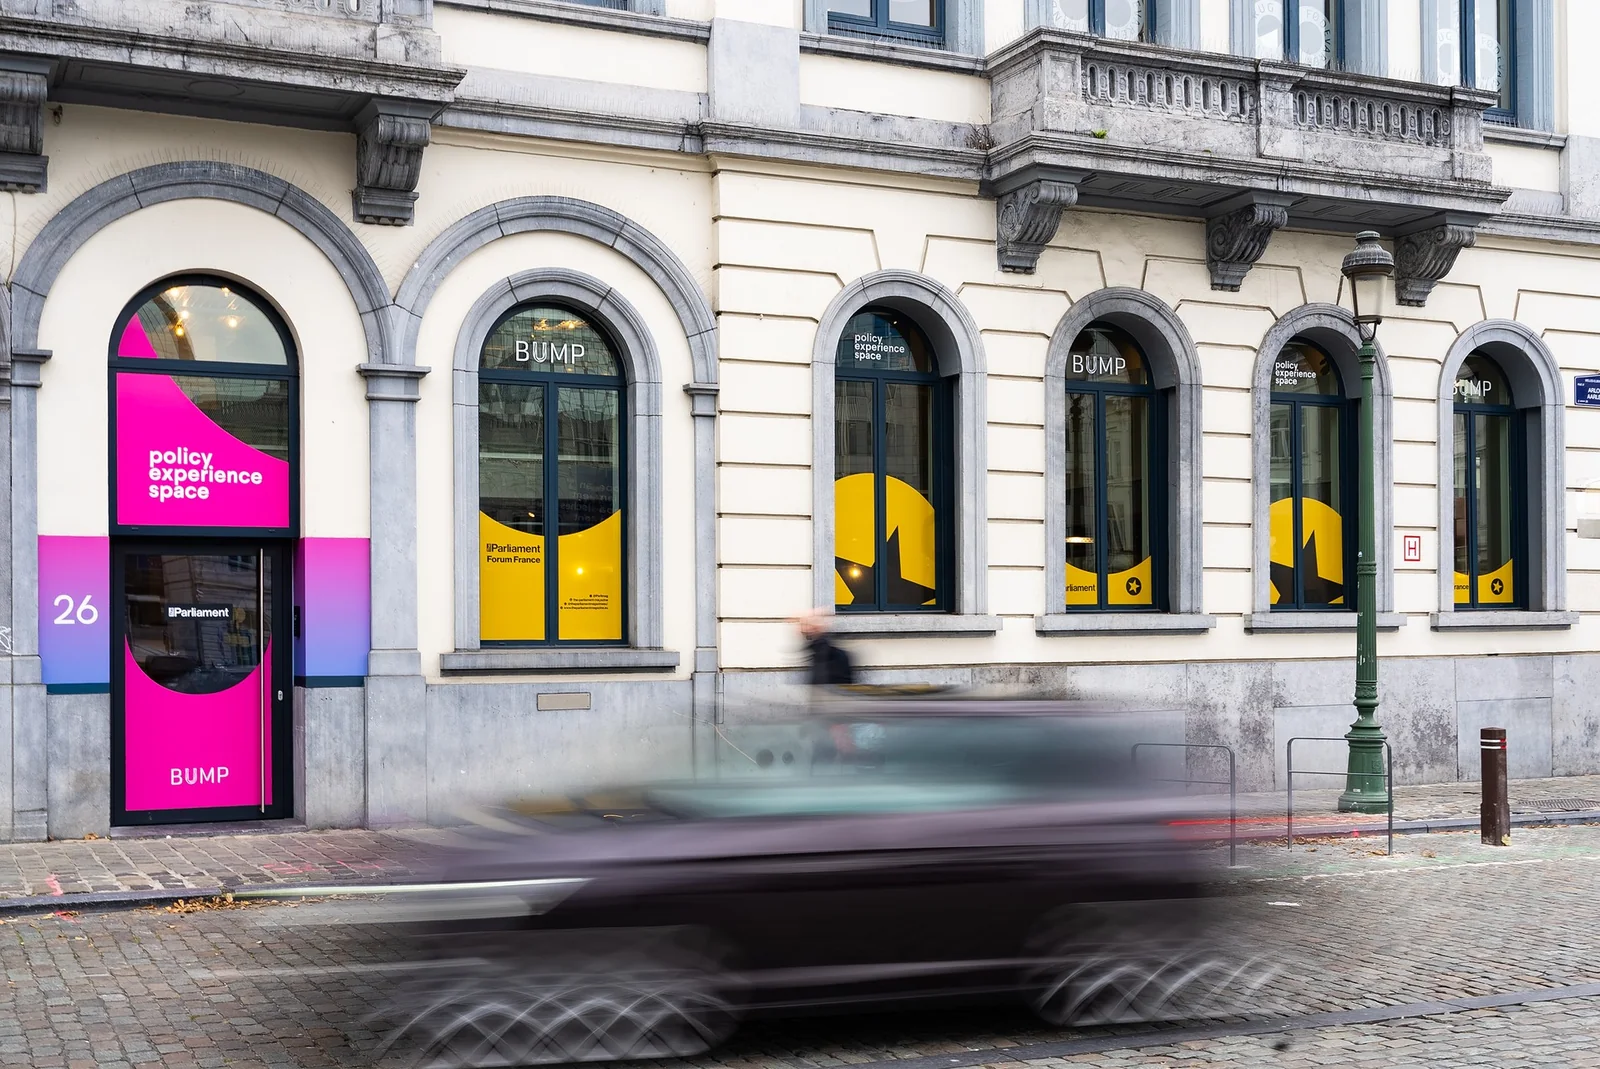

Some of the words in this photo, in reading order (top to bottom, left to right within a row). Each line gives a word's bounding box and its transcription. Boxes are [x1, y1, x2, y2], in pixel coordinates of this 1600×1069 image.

[854, 333, 883, 345] policy
[515, 340, 585, 365] BUMP
[854, 343, 905, 353] experience
[854, 352, 882, 362] space
[1072, 354, 1126, 376] BUMP
[1275, 361, 1299, 371] policy
[1275, 369, 1317, 379] experience
[1275, 377, 1298, 386] space
[149, 446, 213, 470] policy
[148, 465, 263, 486] experience
[148, 484, 210, 503] space
[486, 555, 513, 563] Forum
[513, 555, 541, 564] France
[53, 594, 99, 625] 26
[170, 766, 230, 786] BUMP
